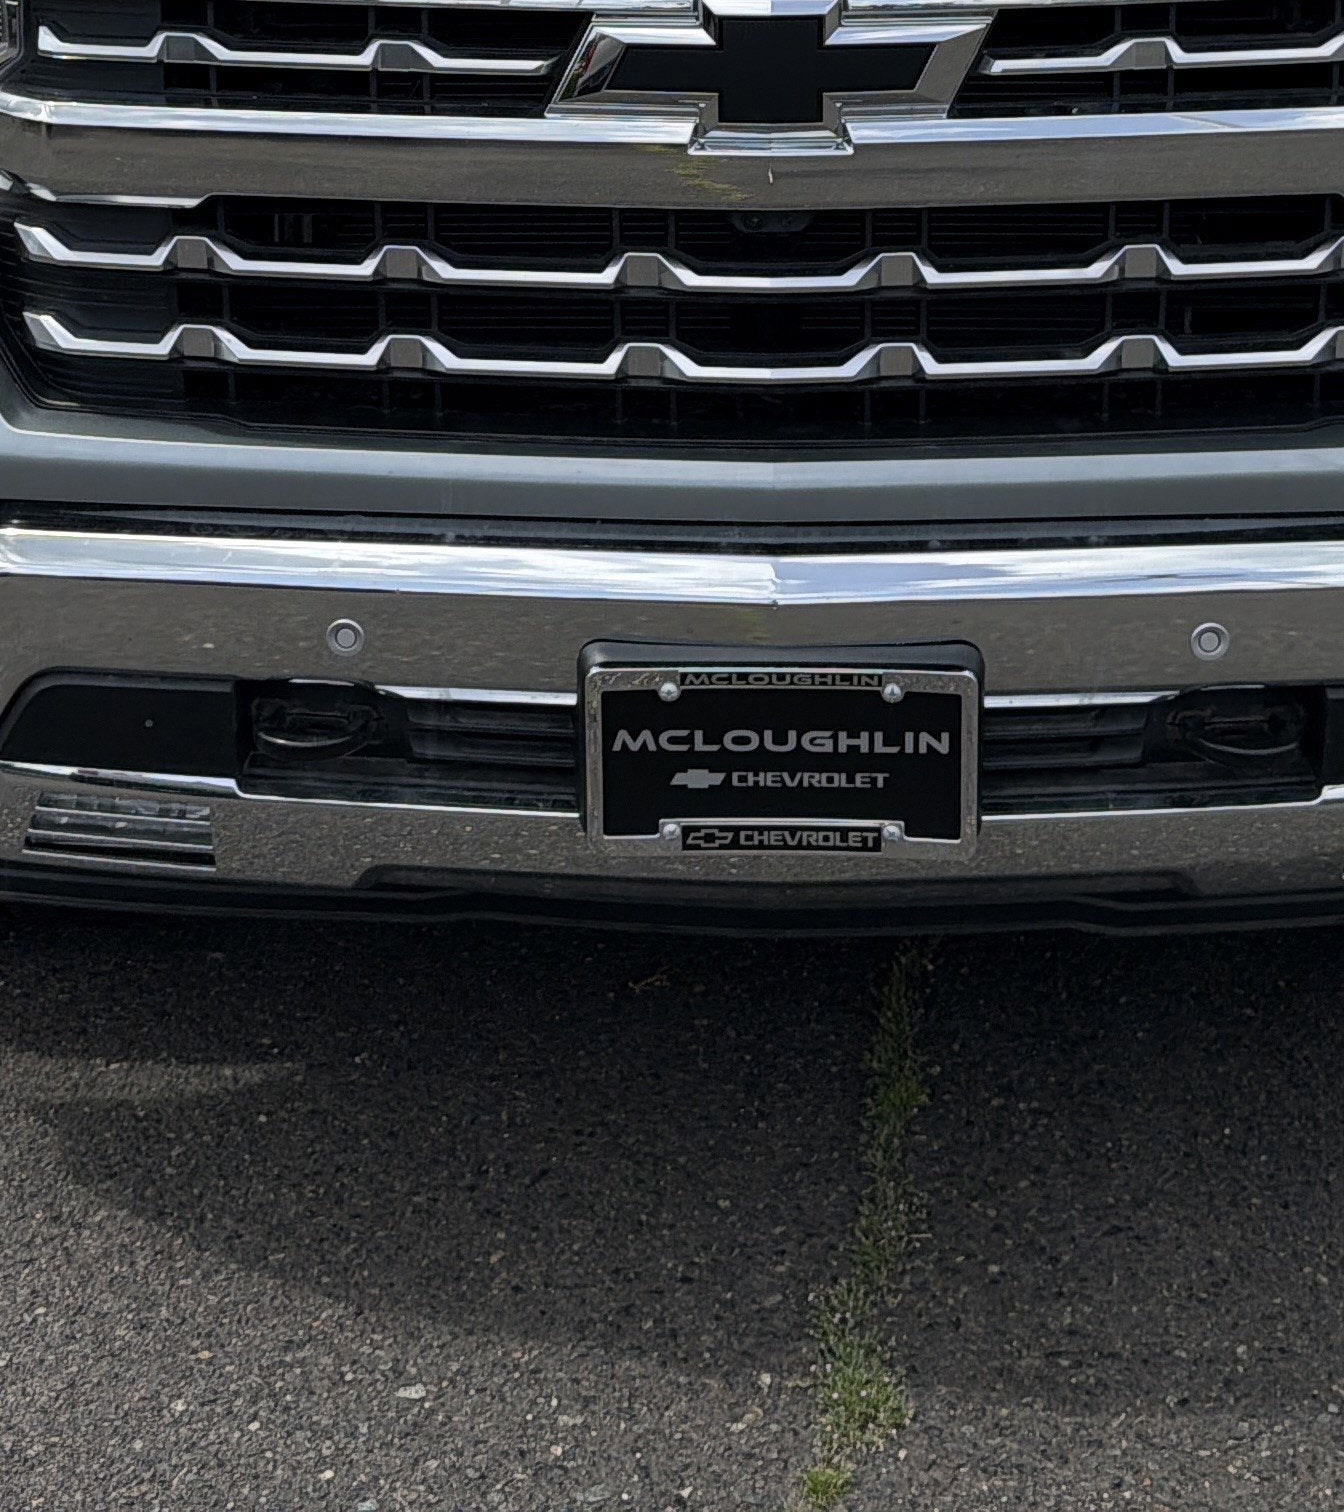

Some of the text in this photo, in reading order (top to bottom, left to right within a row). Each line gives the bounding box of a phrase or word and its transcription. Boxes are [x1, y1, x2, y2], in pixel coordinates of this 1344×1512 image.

[682, 673, 881, 687] MCLOUGHLIN
[611, 729, 950, 755] MCLOUGHLIN
[731, 770, 890, 789] CHEVROLET
[739, 829, 880, 848] CHEVROLET
